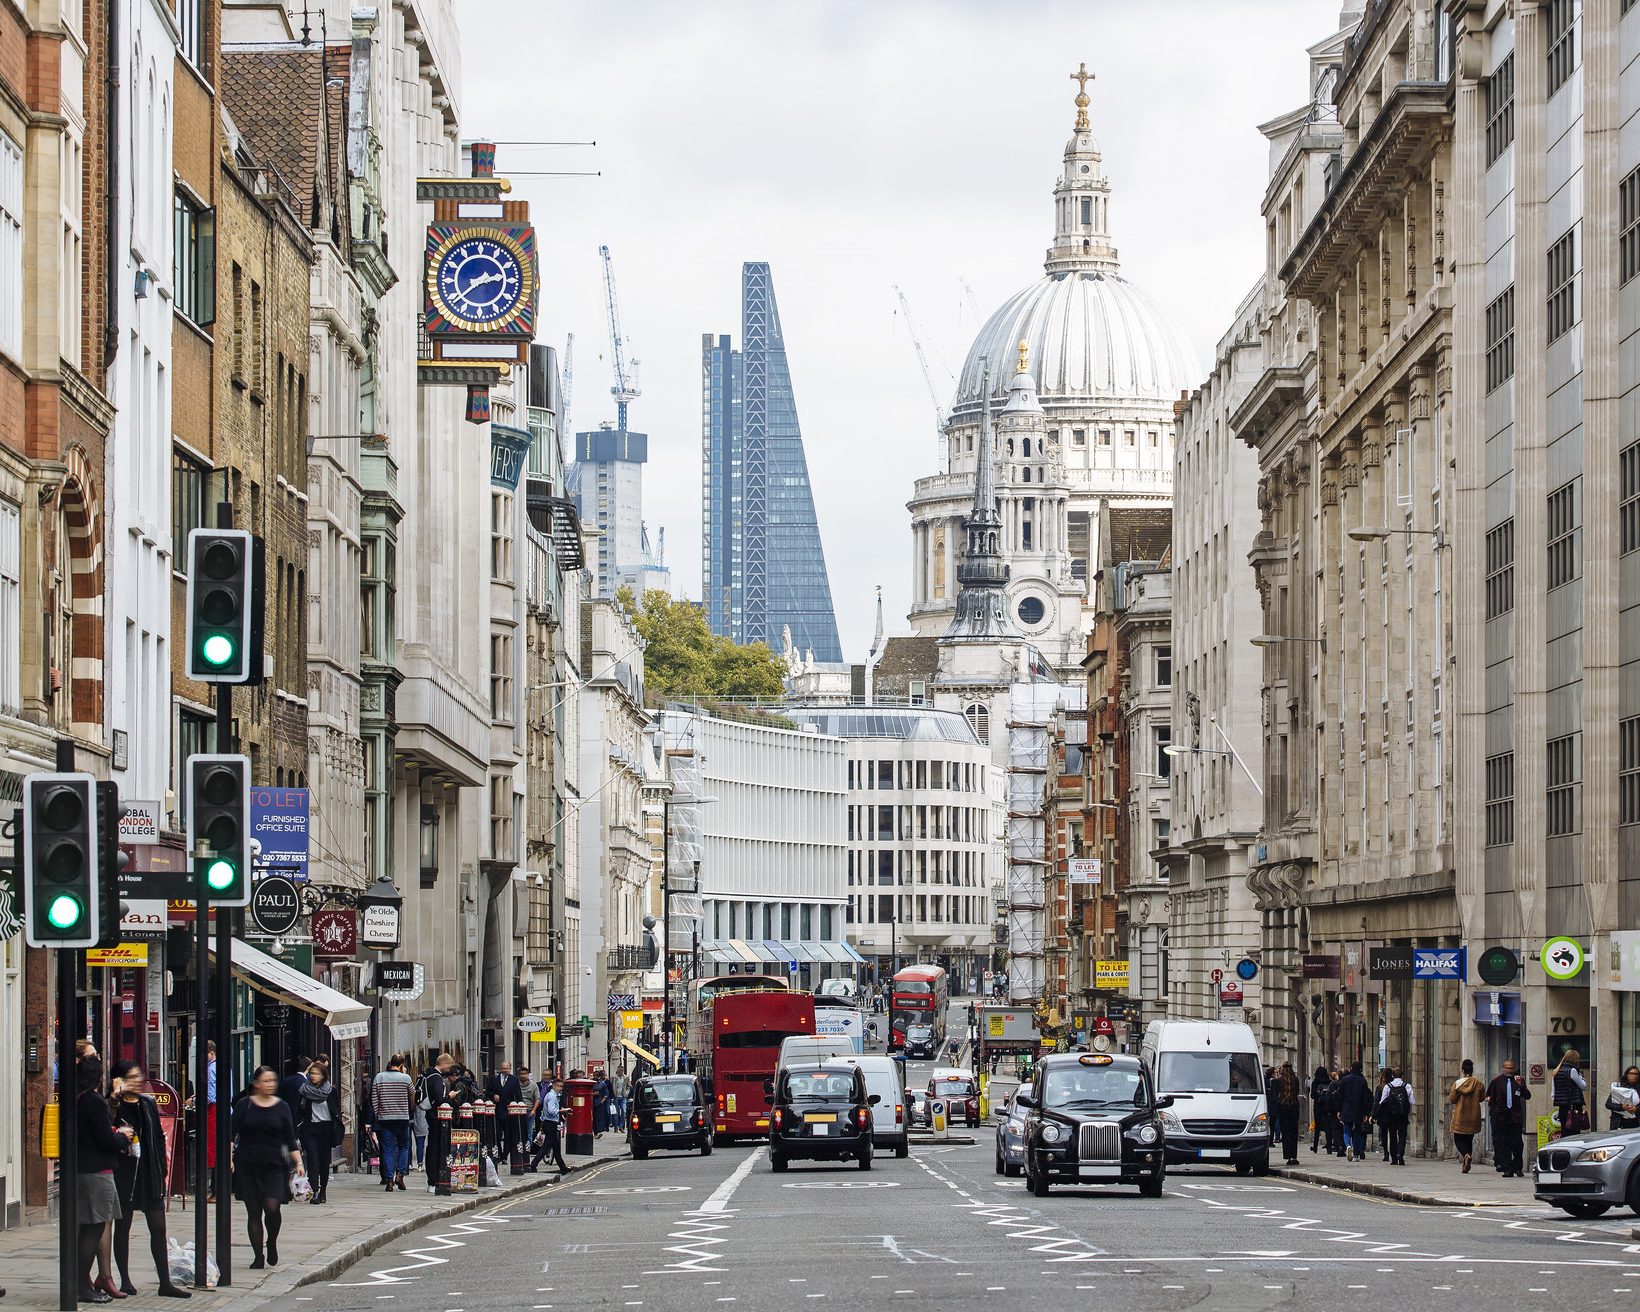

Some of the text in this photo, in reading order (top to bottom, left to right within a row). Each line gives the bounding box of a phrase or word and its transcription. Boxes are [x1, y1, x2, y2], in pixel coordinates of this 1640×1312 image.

[251, 791, 305, 807] TO LET
[126, 809, 150, 818] OBAL
[119, 818, 153, 827] ONDON
[262, 815, 306, 824] FURNISHED
[119, 826, 156, 836] OLLEGE
[255, 823, 306, 833] OFFICE SUITE
[291, 854, 307, 862] 5533
[258, 894, 295, 907] PAUL
[369, 907, 395, 916] Ye Olde
[120, 913, 163, 925] an
[314, 913, 353, 932] ORGANIC COFFEE
[366, 918, 395, 927] Cheshire
[323, 925, 345, 941] PRET
[369, 930, 394, 938] Cheese
[317, 937, 352, 952] NATURAL FOOD
[100, 949, 132, 957] DHL
[1372, 958, 1410, 970] JONES
[1415, 960, 1458, 968] HALIFAX
[383, 970, 411, 980] MEXICAN
[1550, 1017, 1576, 1033] 70
[155, 1095, 169, 1103] AS
